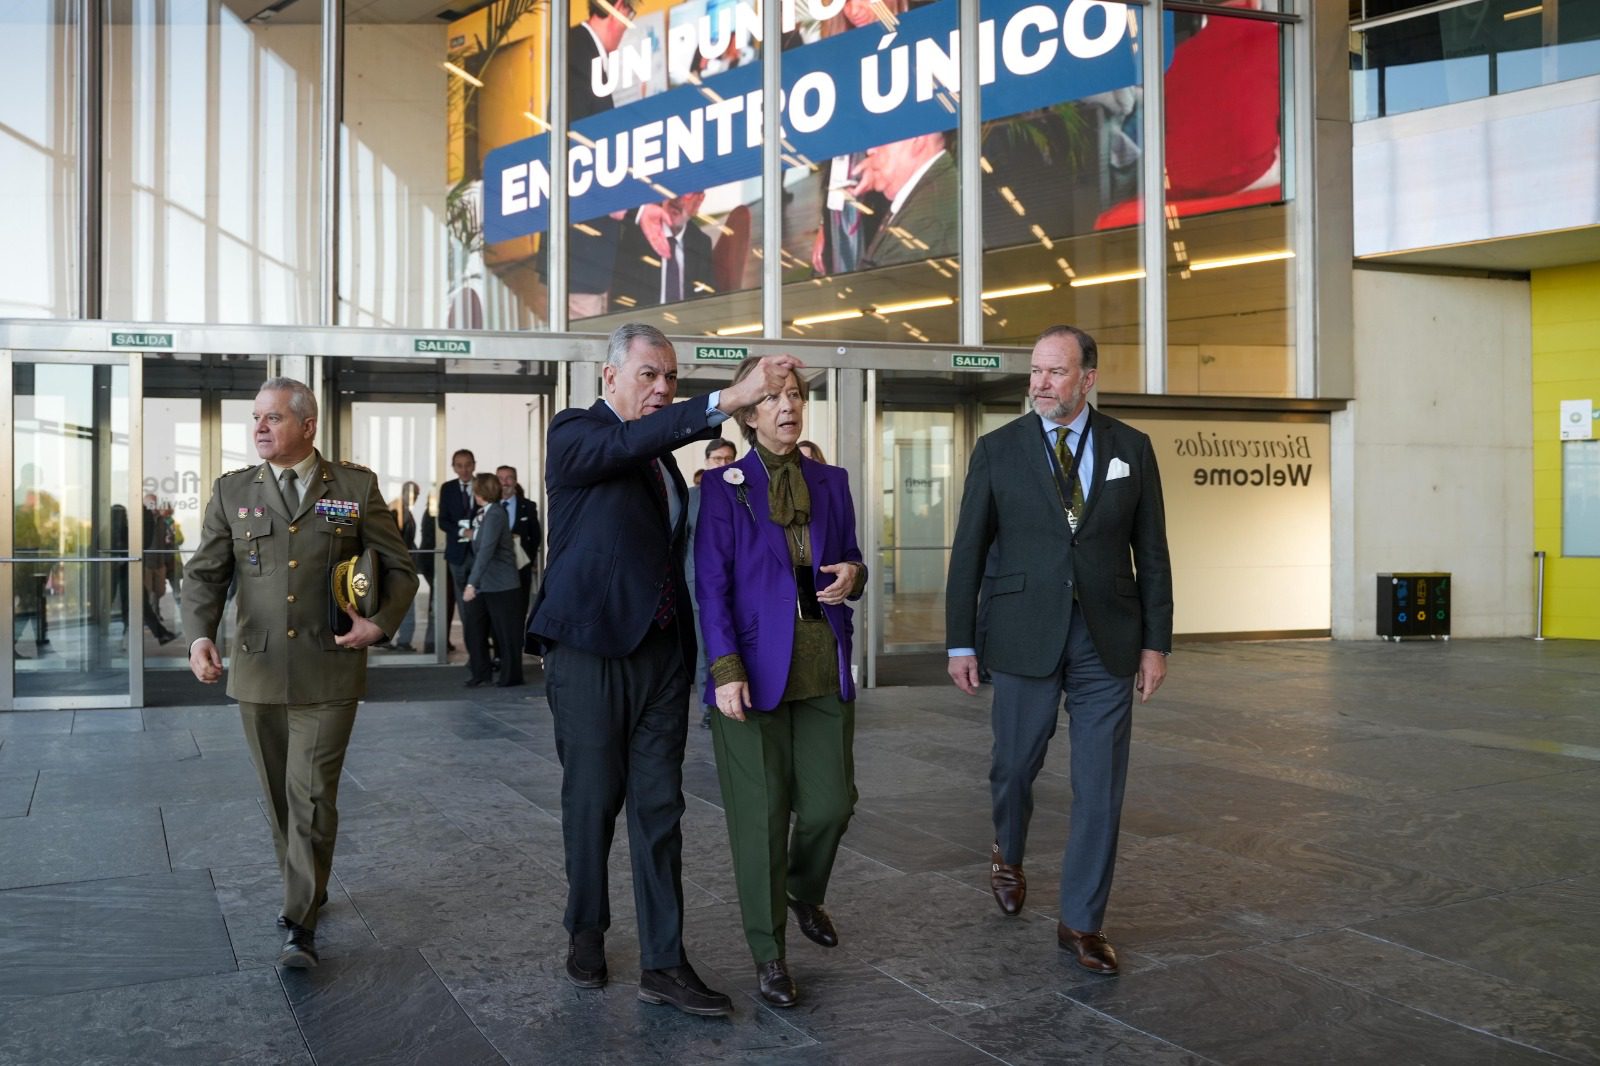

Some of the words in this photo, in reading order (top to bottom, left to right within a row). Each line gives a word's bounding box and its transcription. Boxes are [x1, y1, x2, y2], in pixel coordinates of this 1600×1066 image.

[591, 37, 651, 98] UN
[501, 71, 837, 216] ENCUENTRO
[860, 0, 1128, 114] ÚNICO
[115, 334, 169, 346] SALIDA
[417, 340, 467, 352] SALIDA
[698, 348, 744, 359] SALIDA
[955, 356, 997, 367] SALIDA
